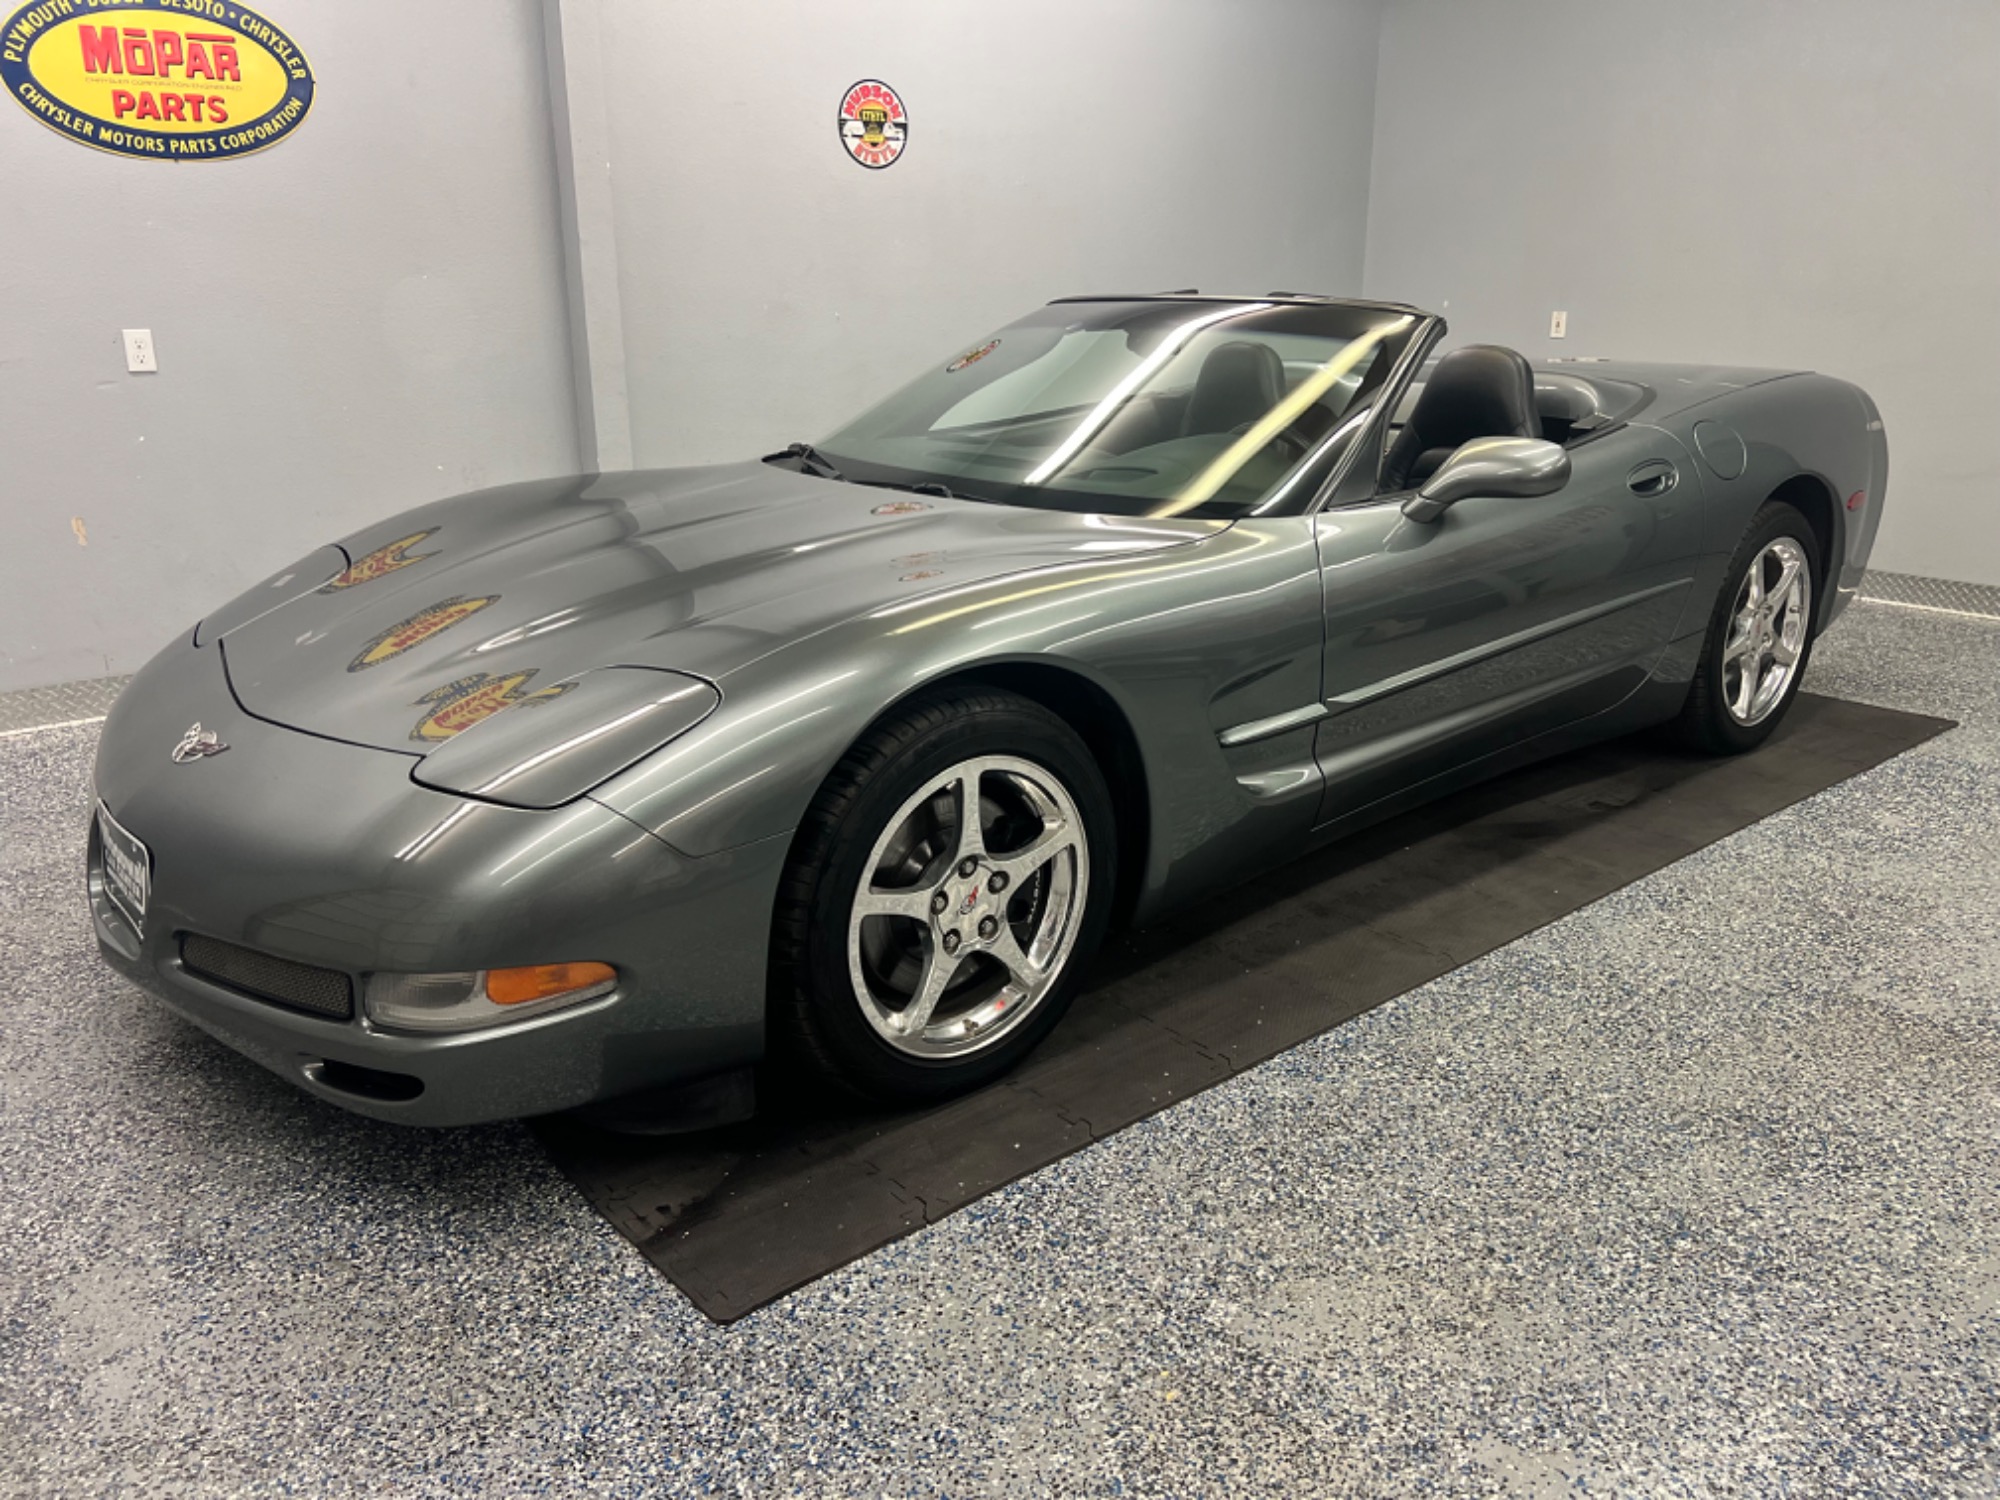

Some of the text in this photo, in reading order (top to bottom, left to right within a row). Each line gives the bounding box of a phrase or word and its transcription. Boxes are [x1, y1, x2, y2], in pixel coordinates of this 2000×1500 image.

[4, 0, 73, 62] PLYMOUTH
[239, 15, 306, 80] CHRYSLER
[19, 82, 304, 153] CHRYSLER MOTORS PARTS CORPORATION
[111, 89, 228, 123] PARTS
